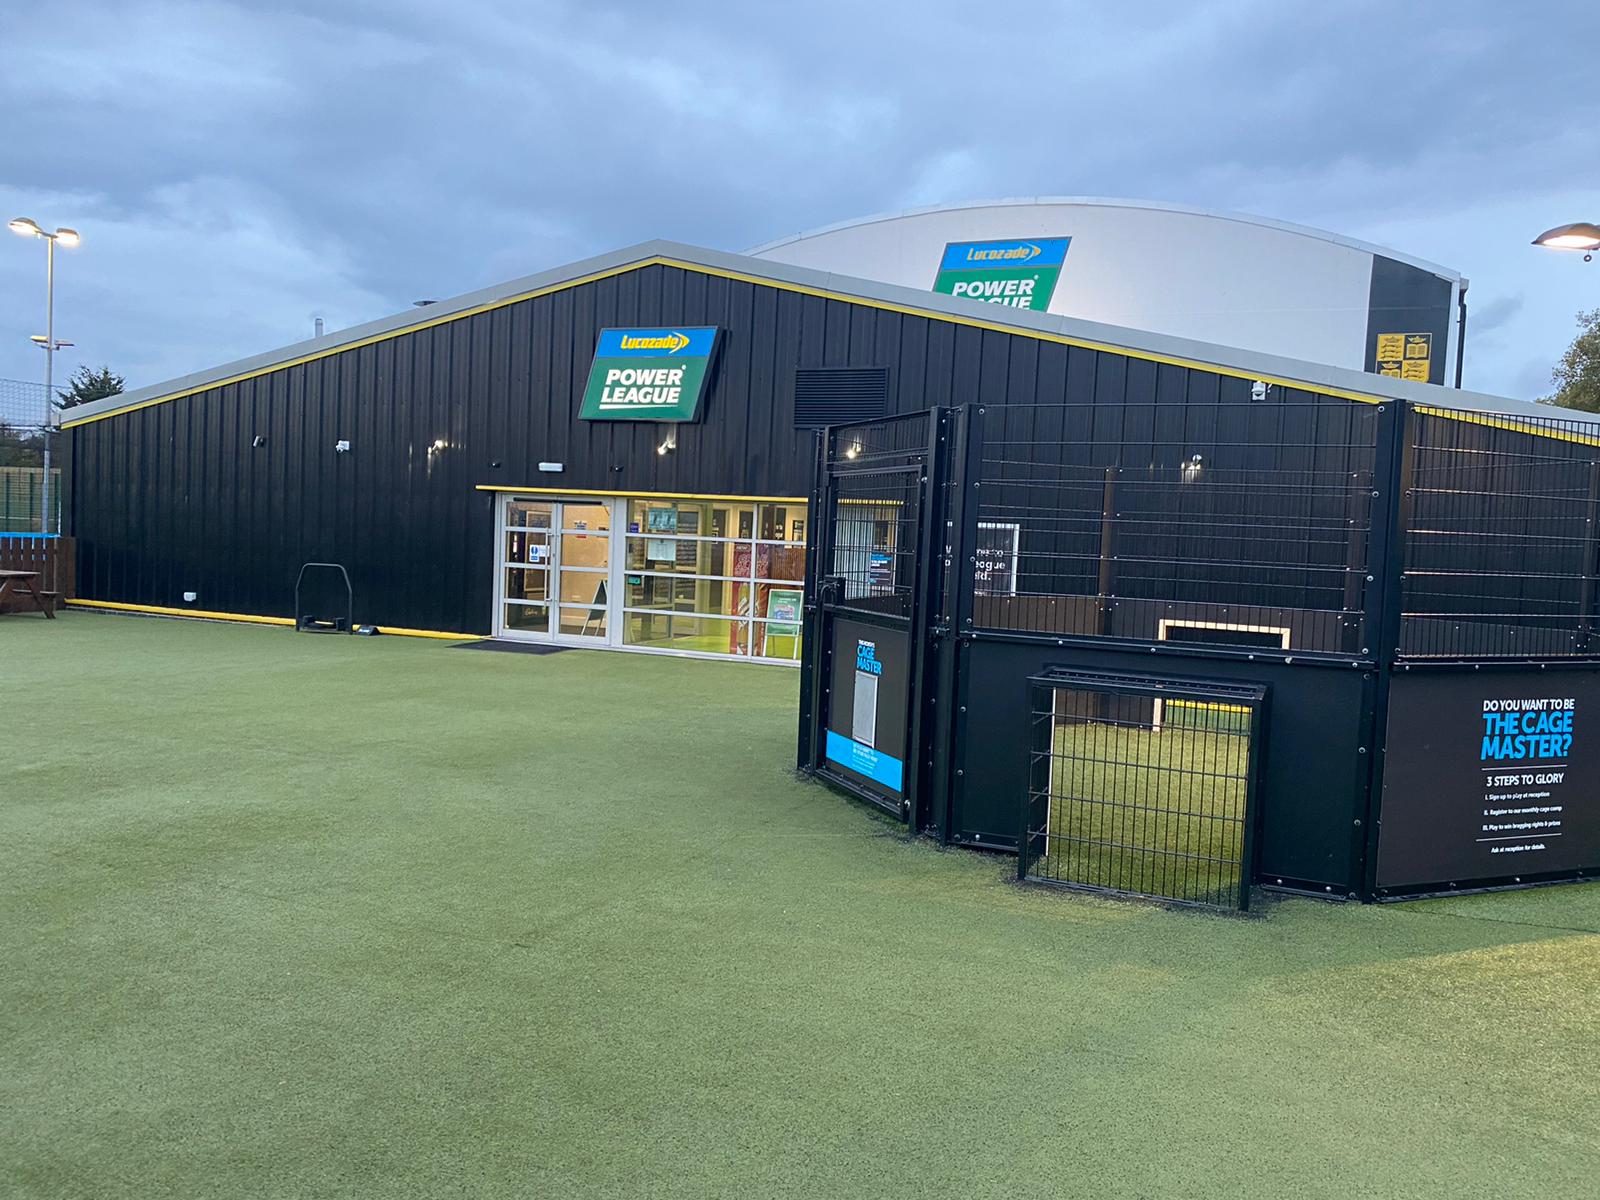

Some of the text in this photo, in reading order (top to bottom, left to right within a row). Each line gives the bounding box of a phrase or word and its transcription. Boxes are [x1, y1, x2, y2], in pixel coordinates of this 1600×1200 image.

[967, 246, 1030, 260] Lucozade
[952, 279, 1035, 297] POWER
[620, 334, 680, 350] Lucozade
[605, 368, 684, 385] POWER
[600, 387, 682, 404] LEAGUE
[857, 644, 875, 660] CAGE
[856, 656, 882, 675] MASTER
[1483, 698, 1575, 711] DO YOU WANT TO BE
[1482, 711, 1574, 735] THE CAGE
[1480, 733, 1573, 761] MASTER?
[1486, 772, 1565, 787] 3 STEPS TO GLORY
[1512, 792, 1523, 800] play
[1528, 791, 1550, 799] reception
[1489, 823, 1498, 831] Play
